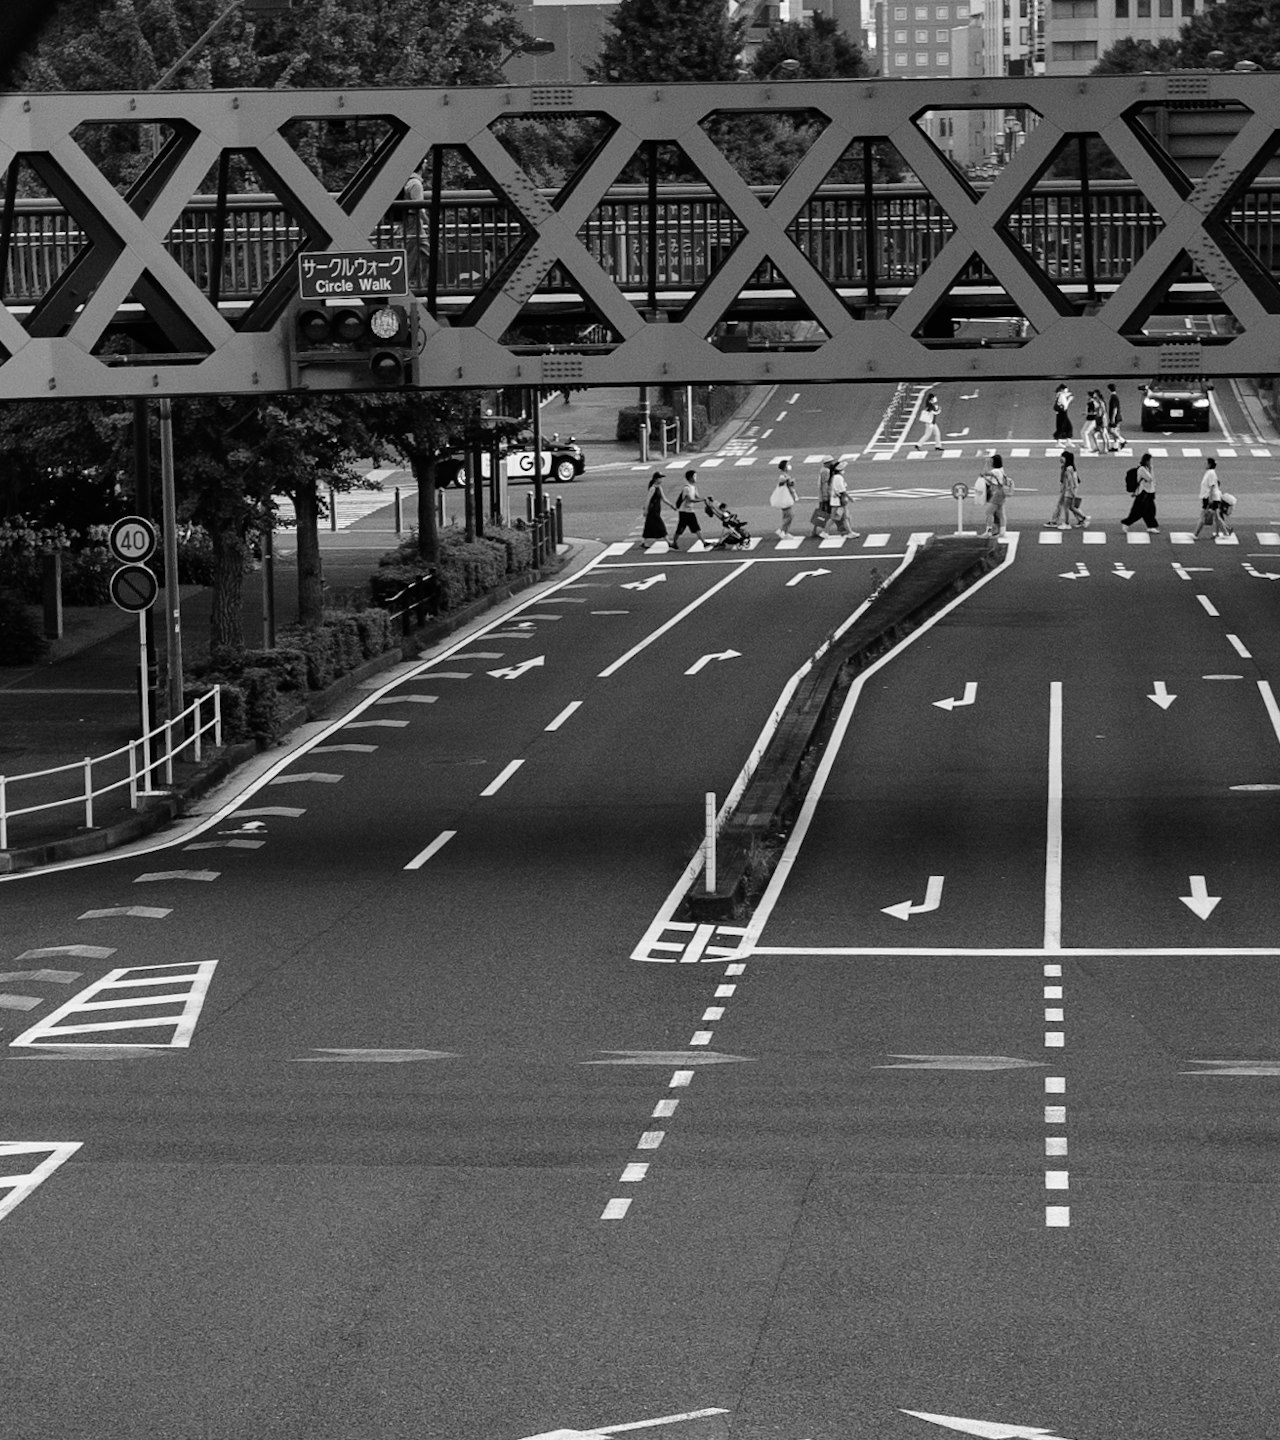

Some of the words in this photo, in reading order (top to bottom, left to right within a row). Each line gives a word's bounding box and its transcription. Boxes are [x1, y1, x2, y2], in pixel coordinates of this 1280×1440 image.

[302, 256, 403, 278] サークルウォーク
[315, 279, 354, 293] Circle
[358, 277, 392, 291] Walk
[120, 530, 145, 551] 40
